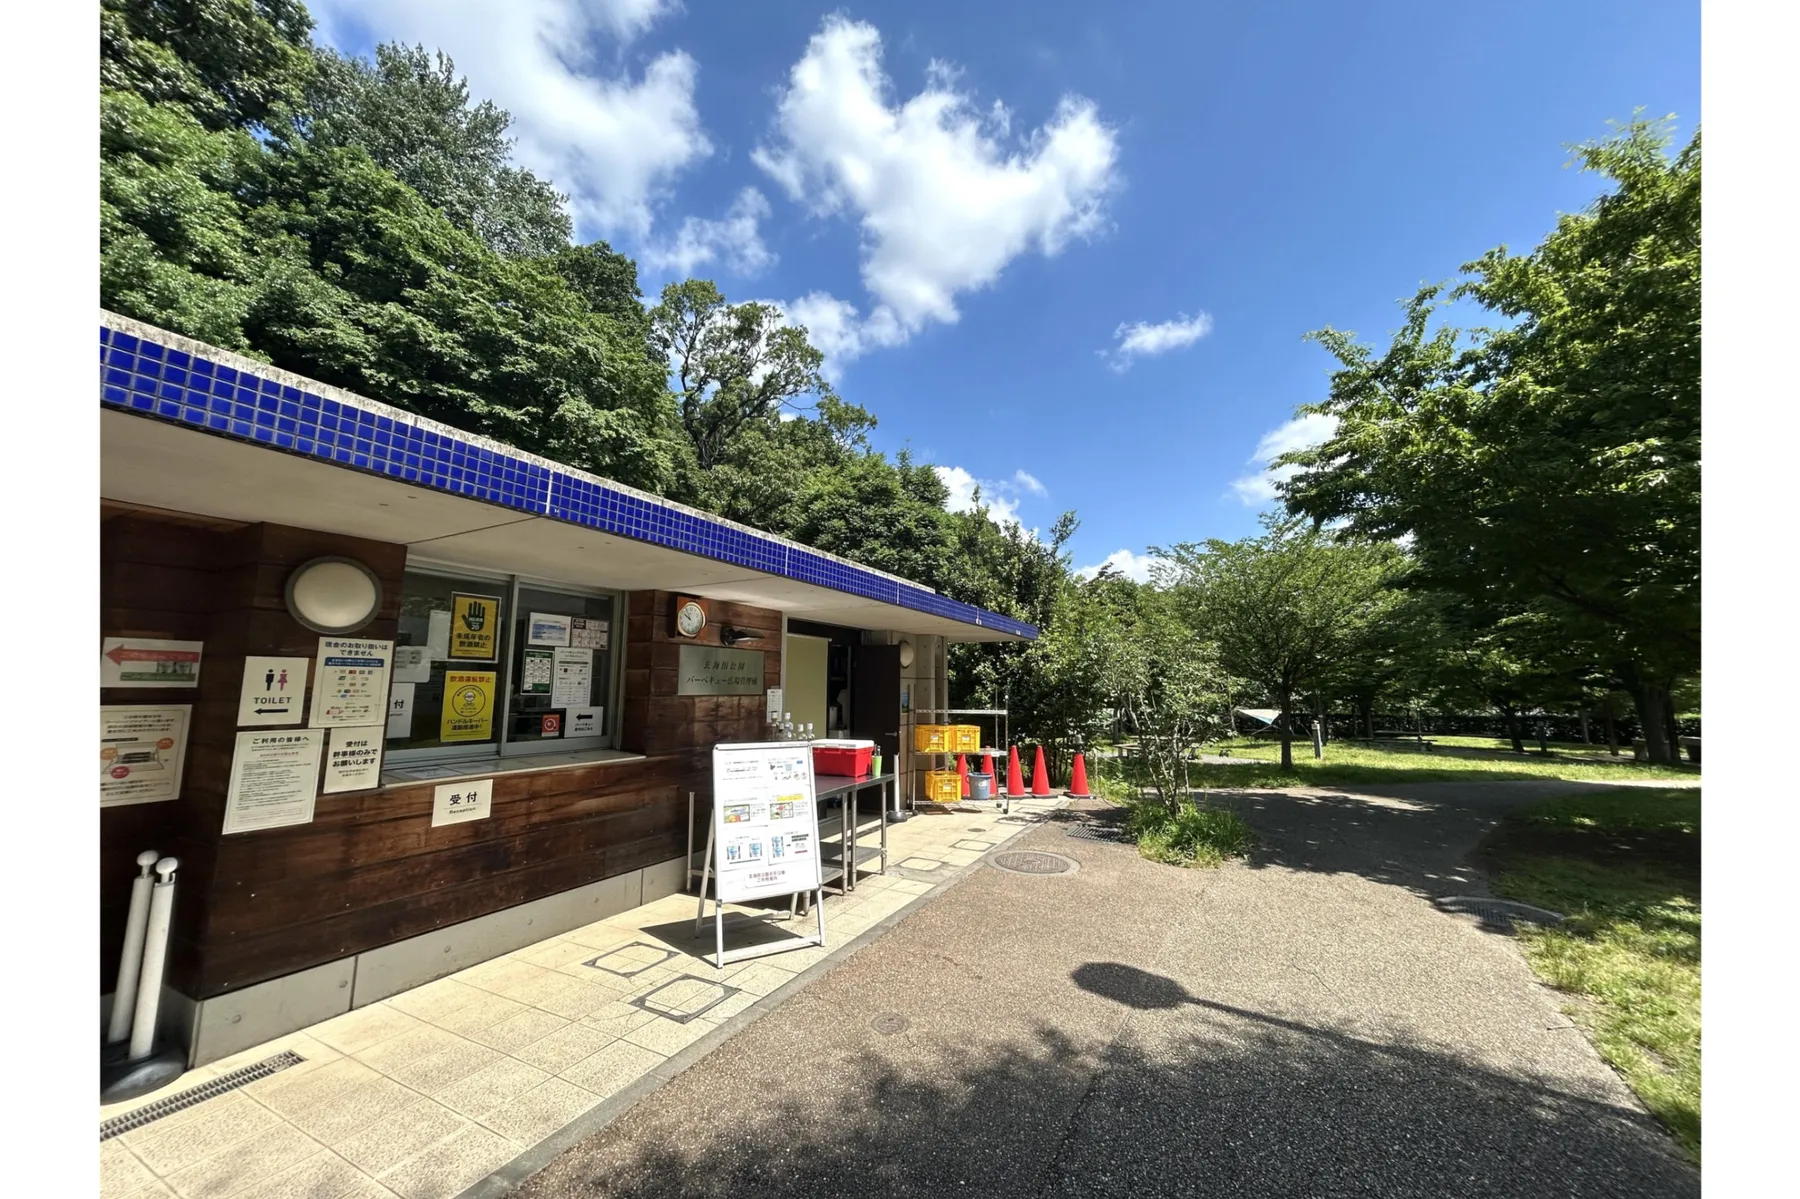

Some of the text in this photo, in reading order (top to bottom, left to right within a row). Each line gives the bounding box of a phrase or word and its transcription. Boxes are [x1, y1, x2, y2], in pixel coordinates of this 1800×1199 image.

[456, 632, 490, 640] 未成年者の
[325, 641, 388, 650] 現金のお取り扱いは
[450, 675, 492, 683] 飲酒運転禁止
[253, 696, 292, 704] TOILET
[447, 717, 489, 725] ハンドルキーパー
[252, 736, 309, 745] ご利用の皆様へ
[345, 740, 368, 748] 受付は
[332, 748, 378, 758] 幹事様のみで
[332, 757, 376, 767] お願いします
[449, 791, 477, 806] 受付
[449, 806, 476, 815] Reception
